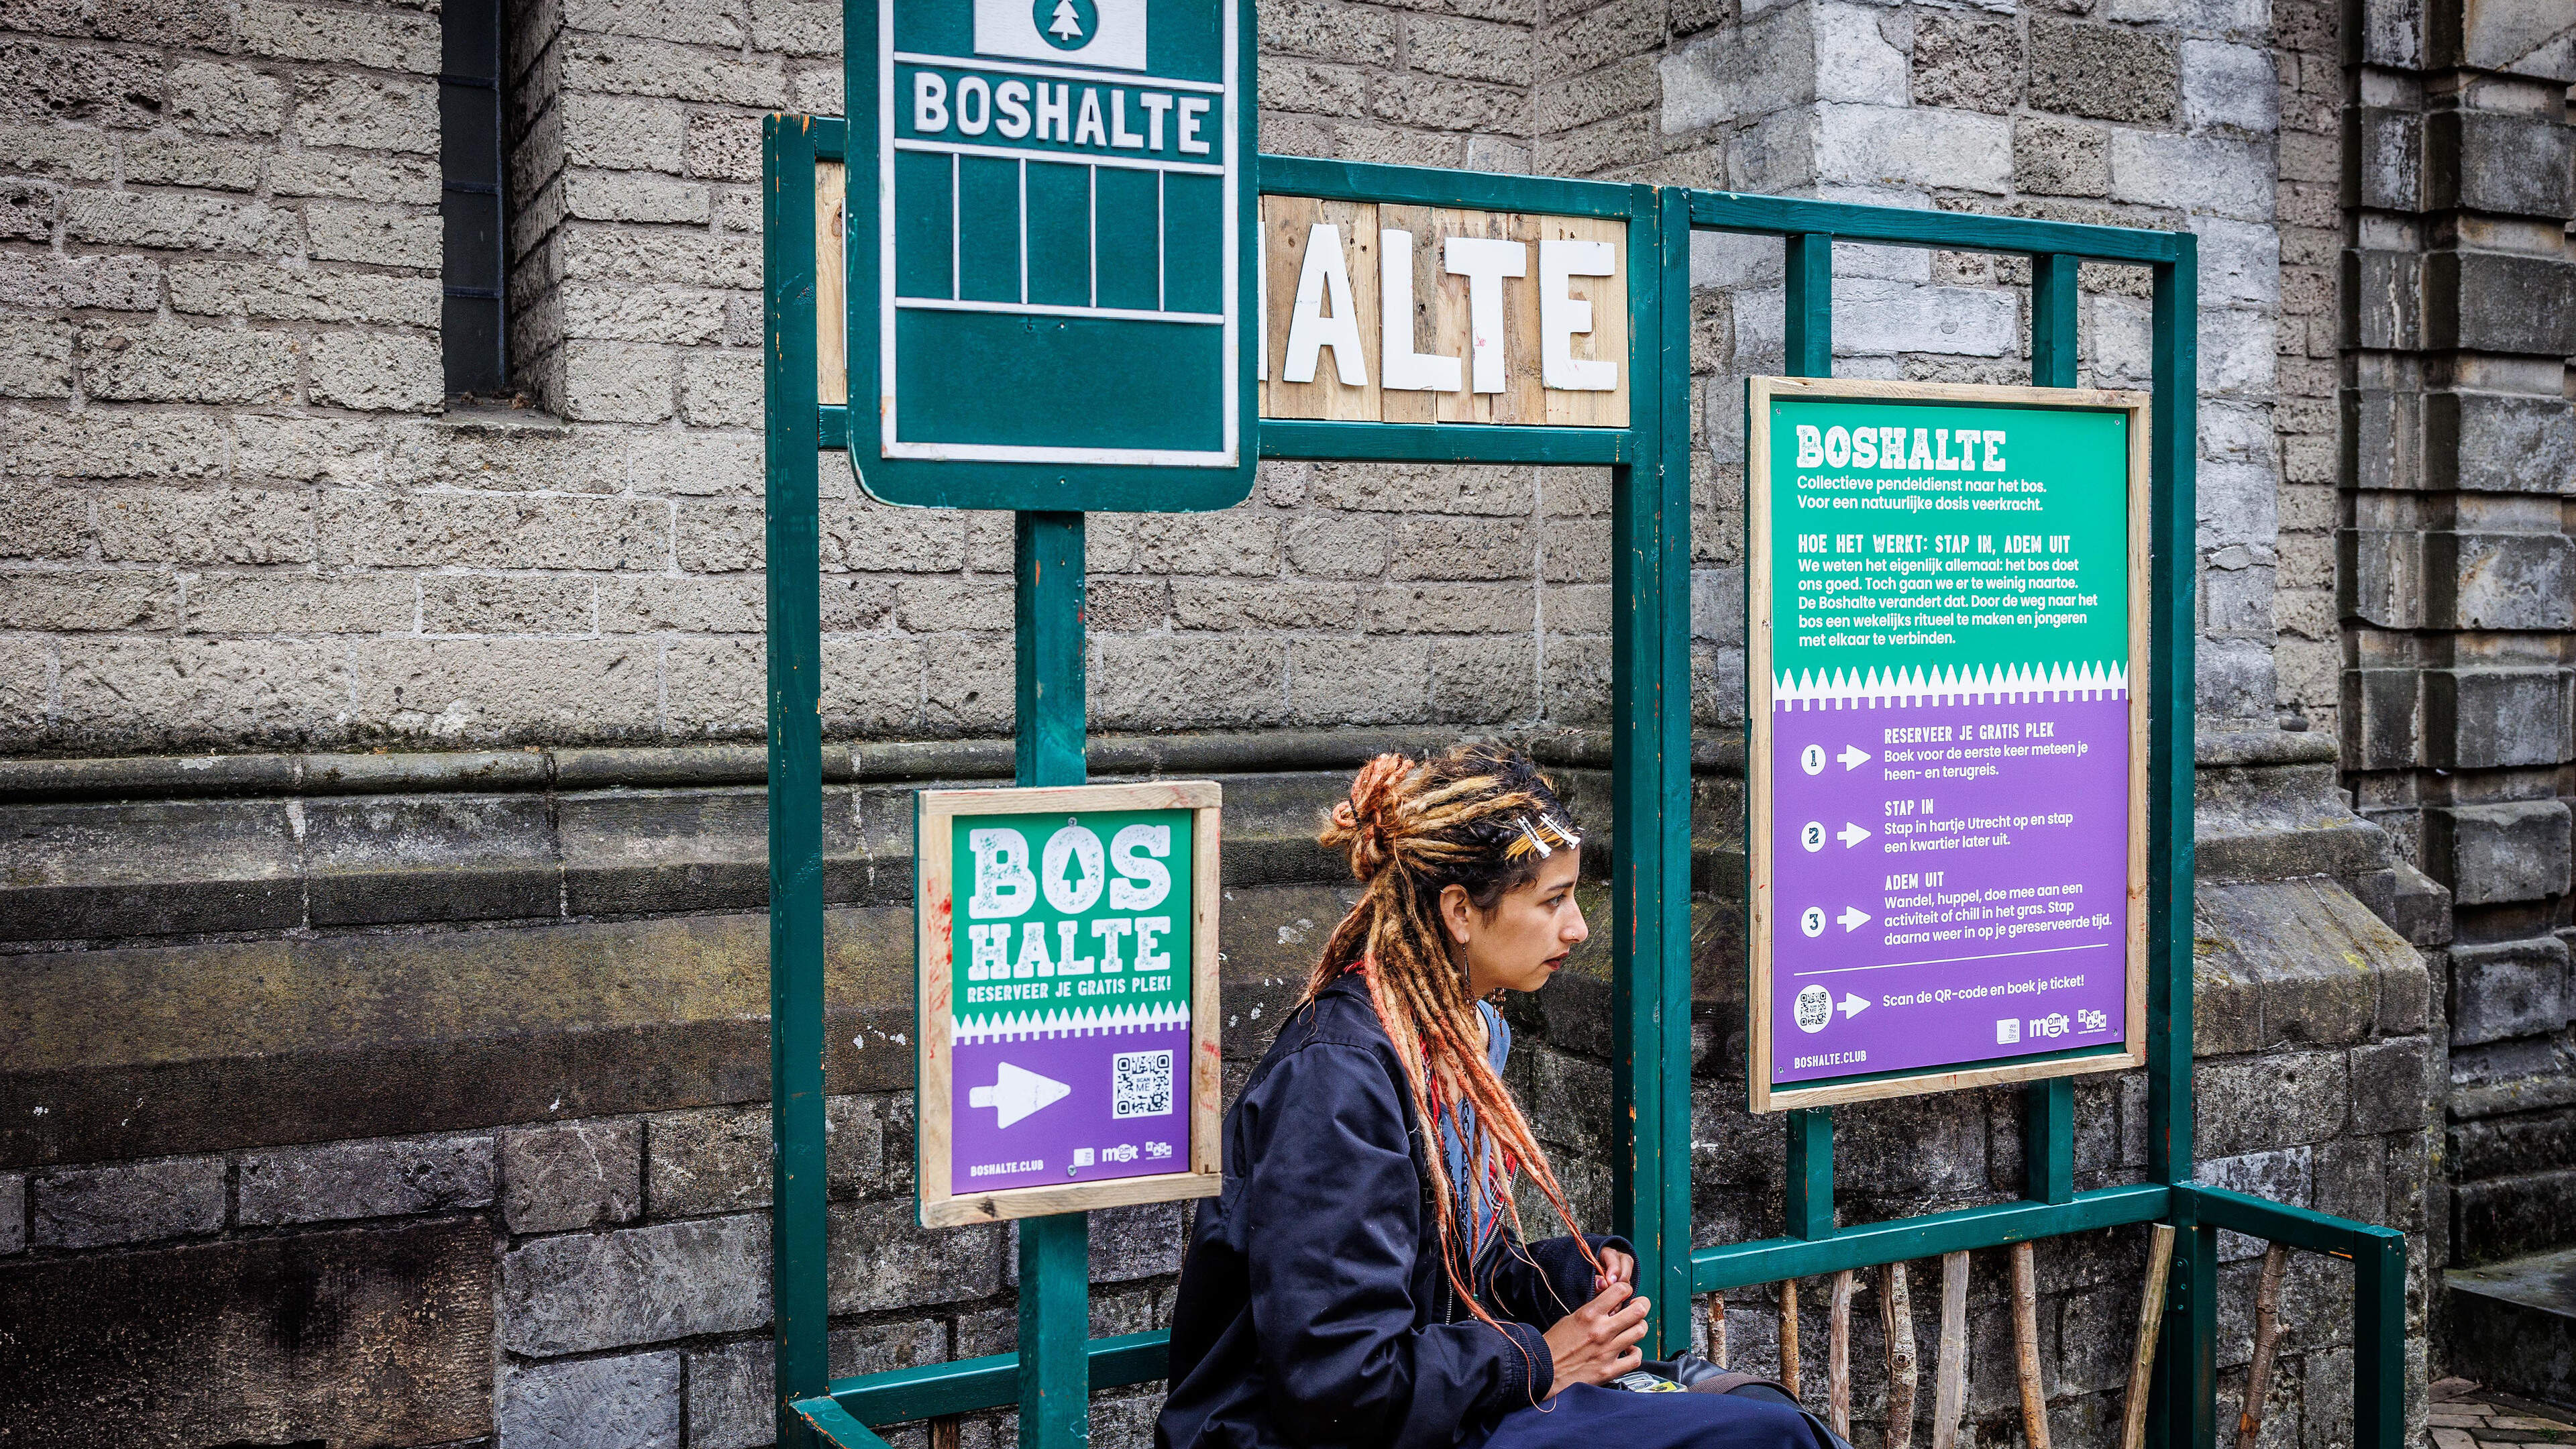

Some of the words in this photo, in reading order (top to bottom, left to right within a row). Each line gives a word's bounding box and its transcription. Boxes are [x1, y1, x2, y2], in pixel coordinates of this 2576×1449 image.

[914, 71, 1210, 155] BOSHALTE
[1258, 221, 1619, 394] ALTE
[1796, 425, 2006, 472] BOSHALTE
[1796, 474, 1874, 490] Collectieve
[1876, 476, 1963, 495] pendeldienst
[1965, 480, 1996, 492] naar
[1998, 478, 2019, 492] het
[2021, 478, 2047, 493] bos.
[1796, 494, 1831, 509] Voor
[1832, 497, 1858, 509] een
[1861, 494, 1933, 514] natuurlijke
[1935, 495, 1970, 511] dosis
[1972, 496, 2043, 511] veerkracht.
[1798, 533, 1827, 553] HOE
[1836, 534, 1864, 553] HET
[1872, 534, 1928, 553] WERKT:
[1935, 535, 1970, 553] STAP
[1978, 535, 1996, 555] IN,
[2004, 535, 2042, 553] ADEM
[2049, 535, 2071, 553] UIT
[1798, 558, 1820, 572] We
[1822, 559, 1863, 572] weten
[1866, 557, 1887, 572] het
[1889, 557, 1943, 576] eigenlijk
[1945, 557, 2003, 572] allemaal:
[2005, 557, 2026, 572] het
[2027, 557, 2050, 572] bos
[2051, 557, 2080, 572] doet
[1798, 579, 1823, 591] ons
[1825, 576, 1862, 595] goed.
[1864, 576, 1896, 590] Toch
[1898, 579, 1933, 594] gaan
[1935, 579, 1954, 590] we
[1955, 579, 1969, 590] er
[1970, 576, 1984, 590] te
[1985, 575, 2026, 594] weinig
[2028, 576, 2079, 589] naartoe.
[1799, 596, 1817, 610] De
[1819, 595, 1876, 609] Boshalte
[1878, 594, 1942, 608] verandert
[1943, 594, 1969, 608] dat.
[1971, 594, 2000, 608] Door
[2002, 594, 2019, 607] de
[2020, 596, 2046, 611] weg
[2047, 596, 2077, 607] naar
[2078, 593, 2098, 606] het
[1799, 614, 1823, 629] bos
[1825, 616, 1851, 628] een
[1853, 612, 1912, 631] wekelijks
[1914, 612, 1954, 627] ritueel
[1956, 612, 1970, 626] te
[1972, 611, 2015, 625] maken
[2017, 614, 2033, 625] en
[2033, 610, 2088, 629] jongeren
[1799, 633, 1826, 647] met
[1828, 632, 1871, 647] elkaar
[1872, 633, 1886, 645] te
[1888, 630, 1956, 645] verbinden.
[1884, 725, 1953, 745] RESERVEER
[1959, 724, 1973, 741] JE
[1979, 722, 2020, 740] GRATIS
[2025, 721, 2055, 739] PLEK
[1810, 749, 1817, 767] 1
[1884, 748, 1915, 763] Boek
[1916, 749, 1945, 761] voor
[1946, 746, 1962, 760] de
[1964, 745, 2002, 759] eerste
[2003, 744, 2030, 757] keer
[2031, 743, 2076, 756] meteen
[2076, 740, 2088, 757] je
[1884, 767, 1922, 781] heen-
[1924, 768, 1940, 779] en
[1942, 762, 1999, 781] terugreis.
[1884, 799, 1915, 816] STAP
[1921, 798, 1934, 814] IN
[1884, 822, 1913, 838] Stap
[1915, 819, 1927, 833] in
[1929, 817, 1966, 835] hartje
[1968, 815, 2011, 830] Utrecht
[2012, 816, 2029, 830] op
[2030, 815, 2045, 826] en
[2047, 812, 2074, 828] stap
[1809, 827, 1819, 845] 2
[1884, 842, 1908, 853] een
[1910, 836, 1960, 852] kwartier
[1962, 835, 1990, 849] later
[1992, 832, 2011, 846] uit.
[968, 824, 1171, 920] BOS
[1884, 873, 1919, 891] ADEM
[1925, 871, 1944, 888] UIT
[1884, 893, 1935, 909] Wandel,
[1937, 889, 1982, 908] huppel,
[1984, 888, 2007, 902] doe
[2008, 888, 2035, 900] mee
[2037, 885, 2060, 897] aan
[2061, 883, 2083, 895] een
[1809, 913, 1819, 930] 3
[1884, 910, 1939, 928] activiteit
[1940, 908, 1953, 923] of
[1955, 906, 1980, 922] chill
[1982, 906, 1993, 919] in
[1996, 904, 2015, 918] het
[2017, 904, 2046, 920] gras.
[2047, 901, 2074, 916] Stap
[1884, 932, 1930, 946] daarna
[1932, 929, 1962, 942] weer
[1964, 925, 1976, 938] in
[1978, 926, 1994, 941] op
[1994, 922, 2006, 940] je
[2008, 915, 2090, 938] gereserveerde
[2091, 913, 2112, 930] tijd.
[967, 916, 1171, 981] HALTE
[967, 983, 1049, 1003] RESERVEER
[1055, 981, 1071, 998] JE
[1077, 978, 1126, 996] GRATIS
[1132, 975, 1171, 993] PLEK!
[1882, 994, 1914, 1007] Scan
[1916, 990, 1933, 1004] de
[1934, 985, 1988, 1004] QR-code
[1990, 985, 2005, 996] en
[2007, 979, 2036, 994] boek
[2037, 978, 2048, 996] je
[2049, 974, 2084, 989] ticket!
[1794, 1050, 1867, 1069] BOSHALTE.CLUB
[1136, 1083, 1150, 1092] ME
[970, 1159, 1044, 1177] BOSHALTE.CLUB
